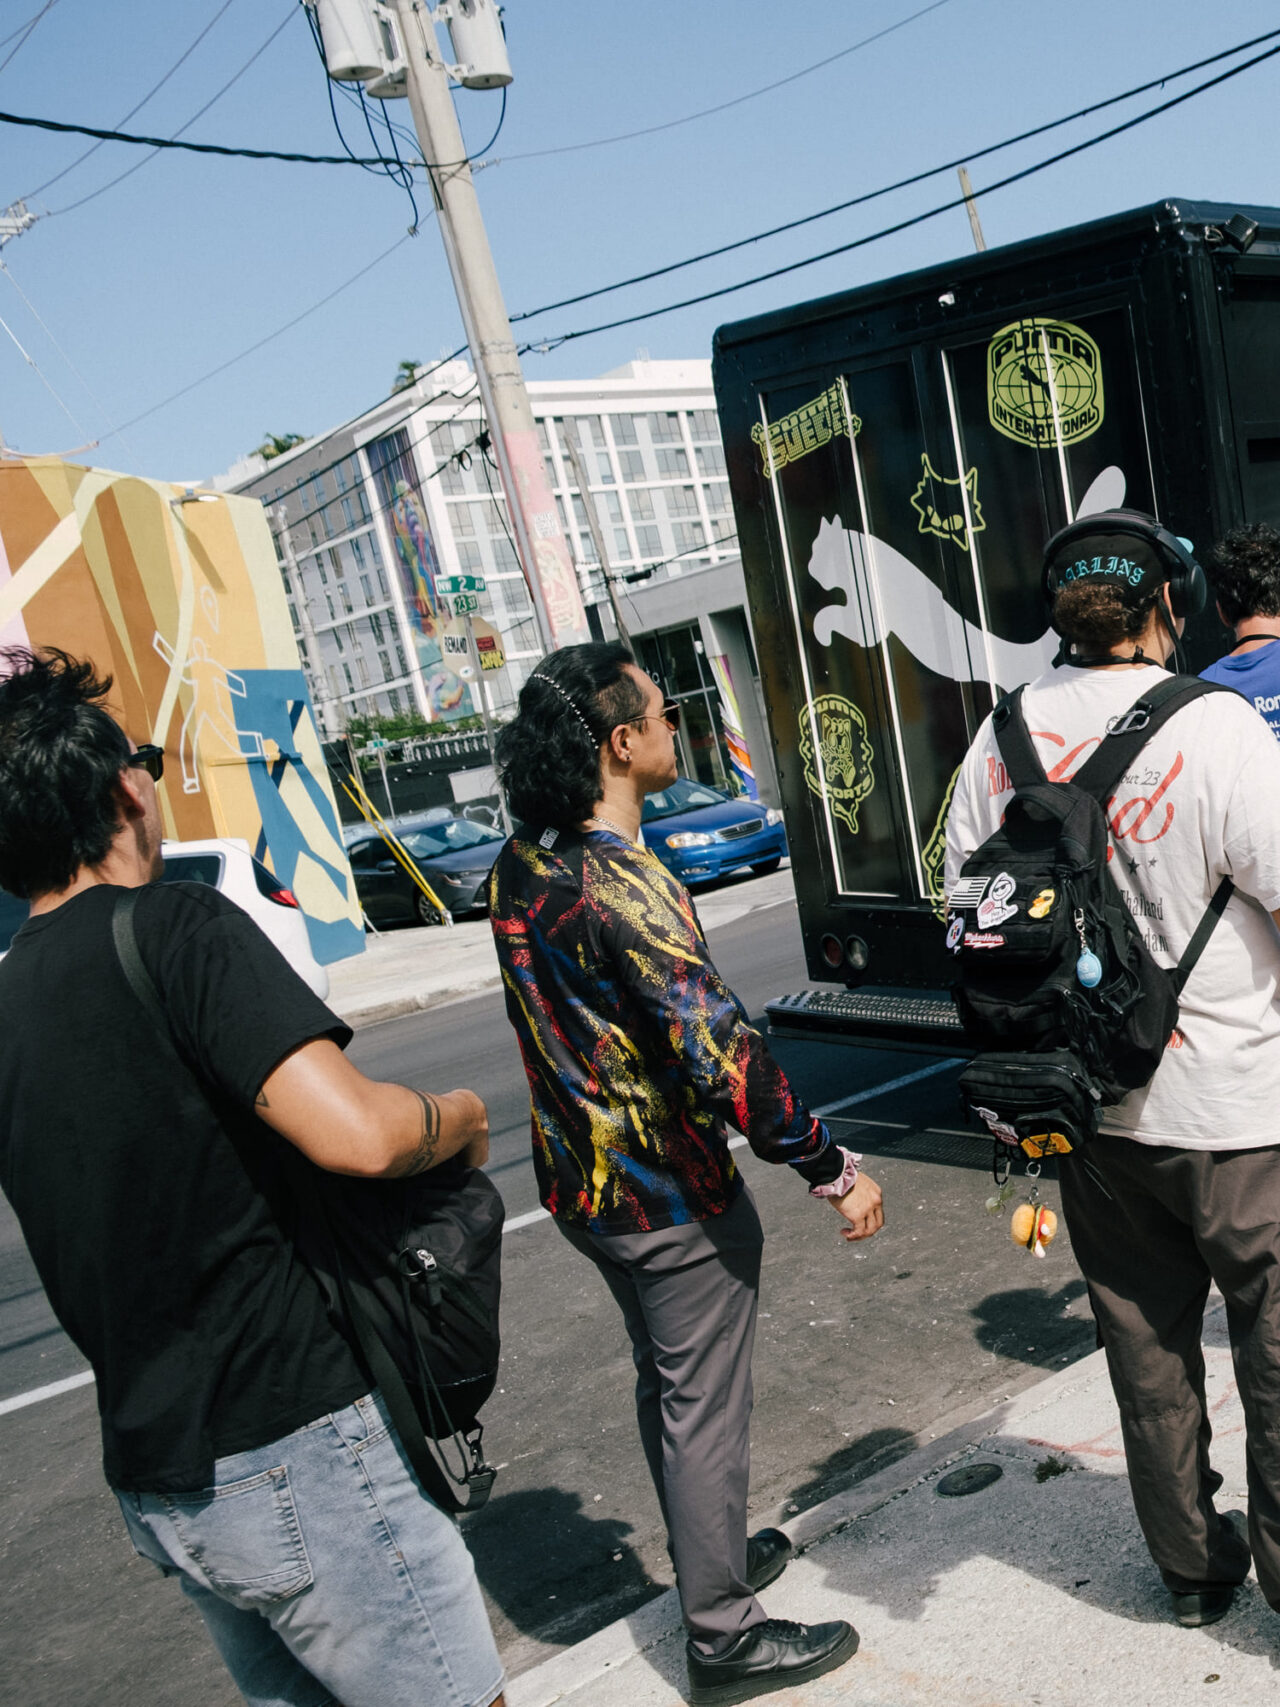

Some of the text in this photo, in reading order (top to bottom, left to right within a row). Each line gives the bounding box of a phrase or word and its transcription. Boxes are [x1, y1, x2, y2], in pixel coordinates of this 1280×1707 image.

[994, 329, 1093, 369] PUMA
[995, 402, 1096, 440] INTERNATIONAL
[437, 581, 452, 592] NW
[457, 576, 468, 593] 2
[1059, 556, 1146, 587] ARLINS
[456, 596, 467, 613] 23
